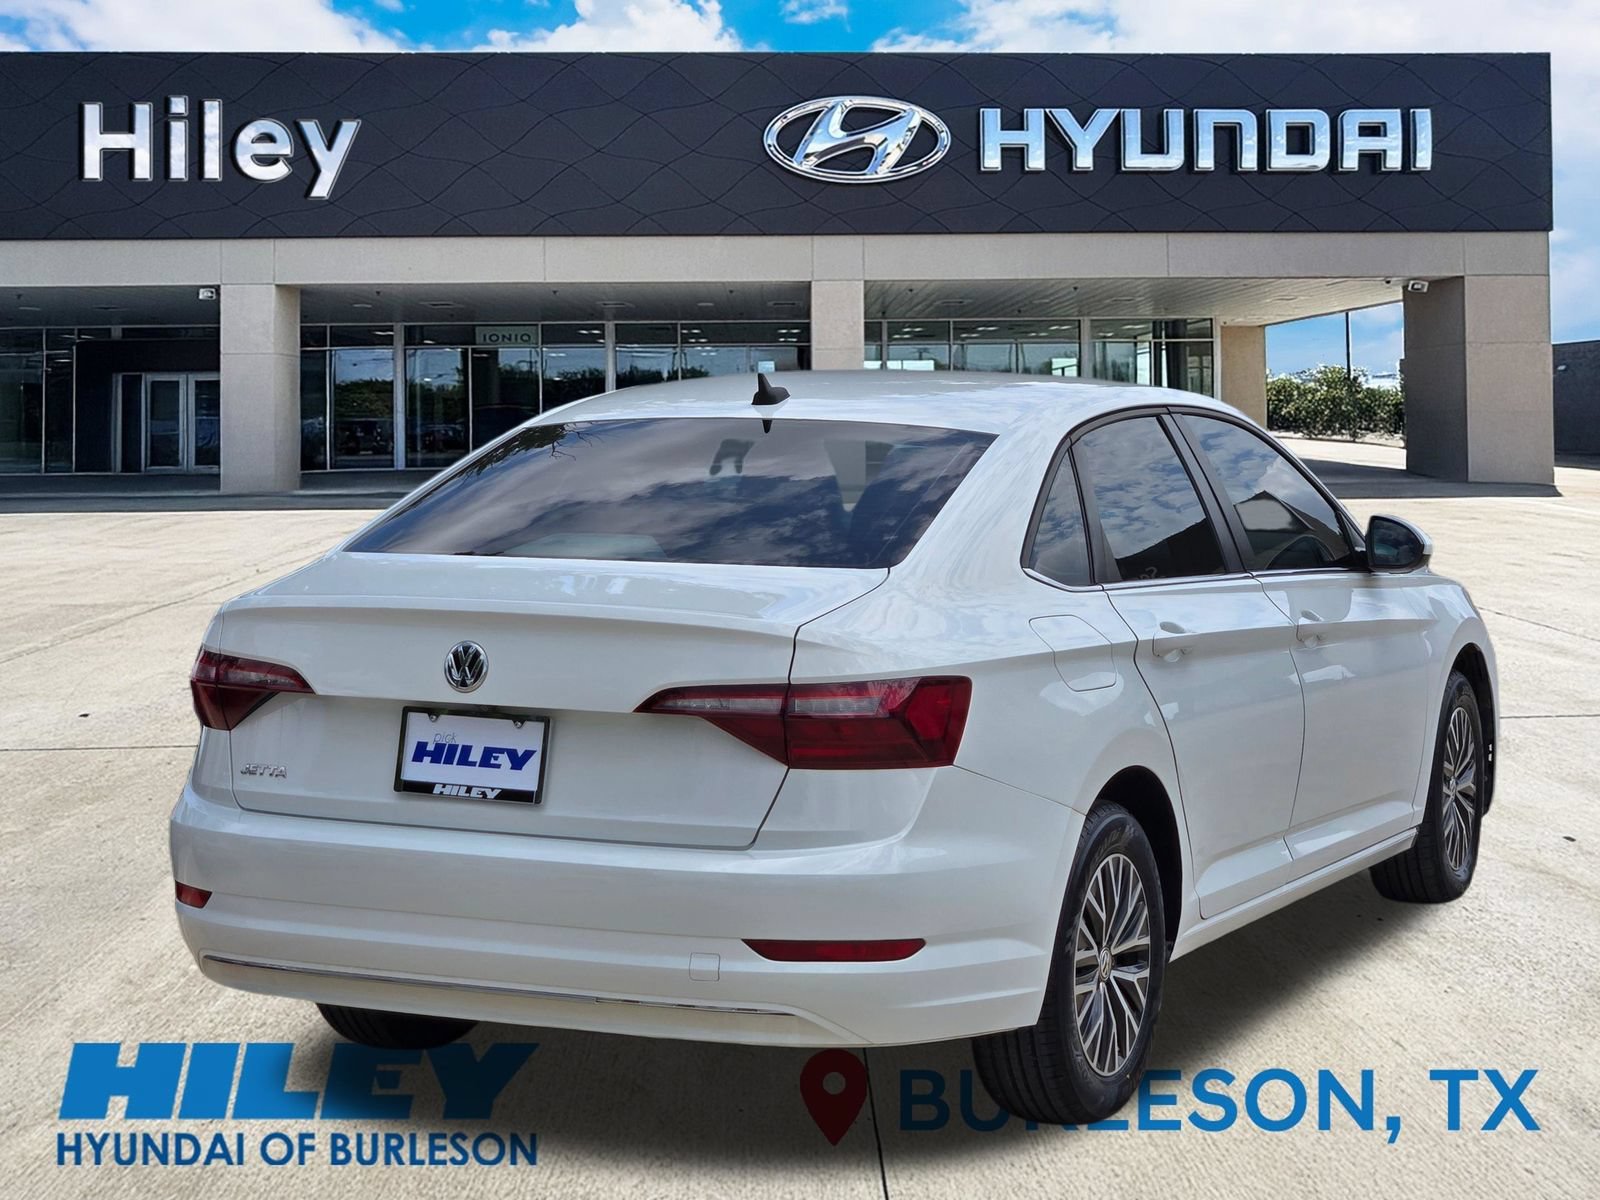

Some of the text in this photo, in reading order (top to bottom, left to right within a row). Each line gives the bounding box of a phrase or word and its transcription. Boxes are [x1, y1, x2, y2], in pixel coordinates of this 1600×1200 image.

[79, 95, 361, 200] Hiley
[979, 107, 1432, 172] HYUNDAI
[433, 731, 457, 744] pick
[412, 741, 537, 771] HILEY
[241, 764, 287, 779] JETTA
[433, 784, 502, 800] HILEY
